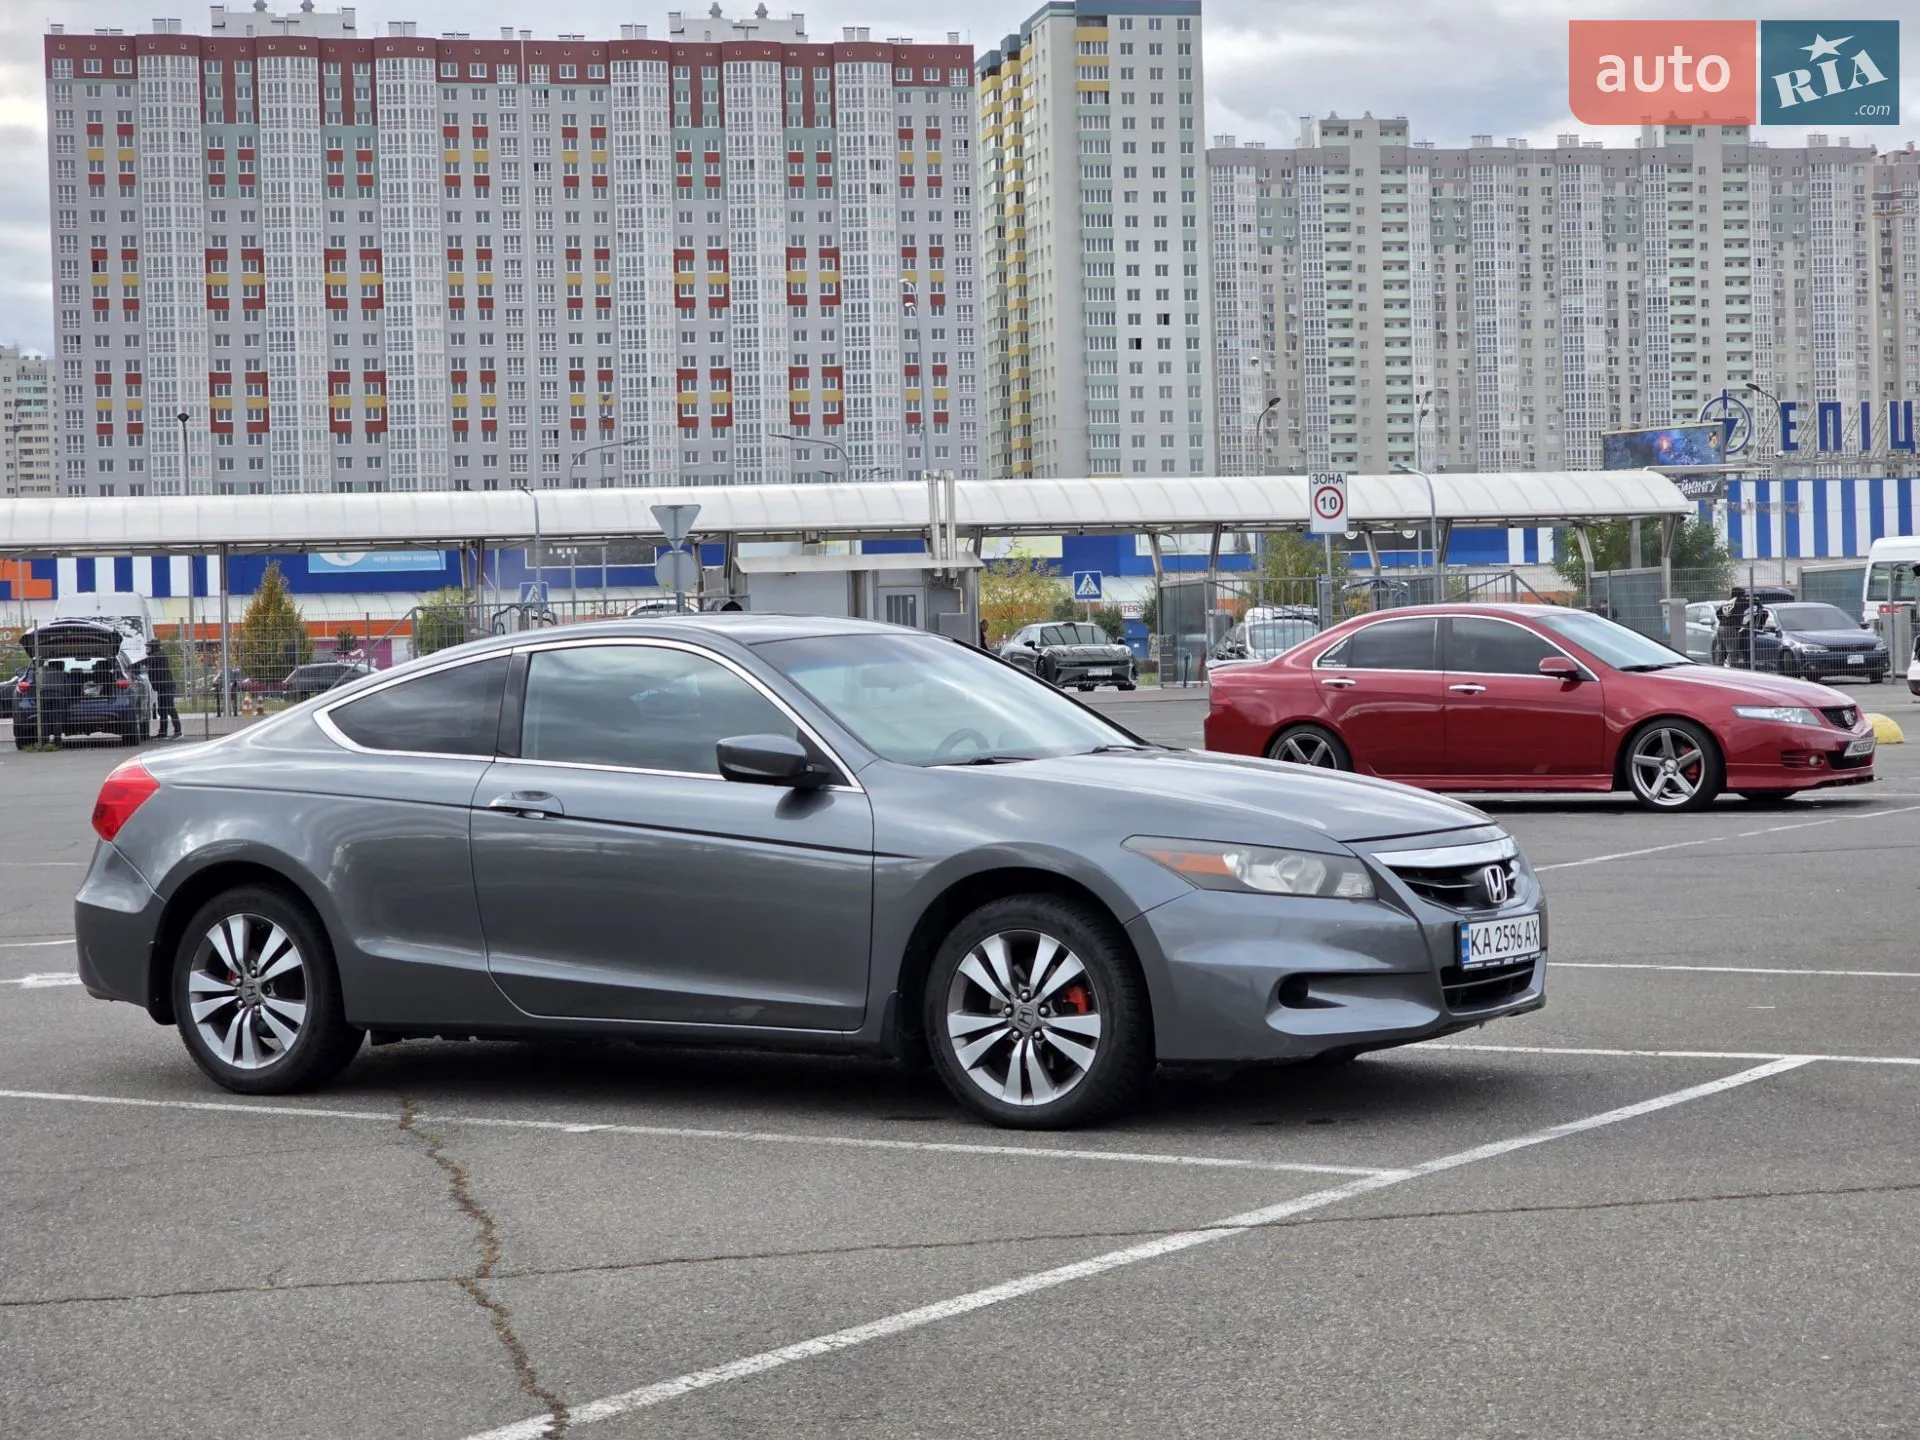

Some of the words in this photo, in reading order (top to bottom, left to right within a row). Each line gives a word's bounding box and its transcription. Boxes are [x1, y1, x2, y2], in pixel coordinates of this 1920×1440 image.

[1780, 400, 1916, 453] ЕПІЦ
[1312, 473, 1344, 485] ЗОНА
[1320, 496, 1338, 510] 10
[1471, 927, 1492, 956] KA
[1495, 924, 1522, 953] 2596
[1524, 920, 1539, 948] AX
